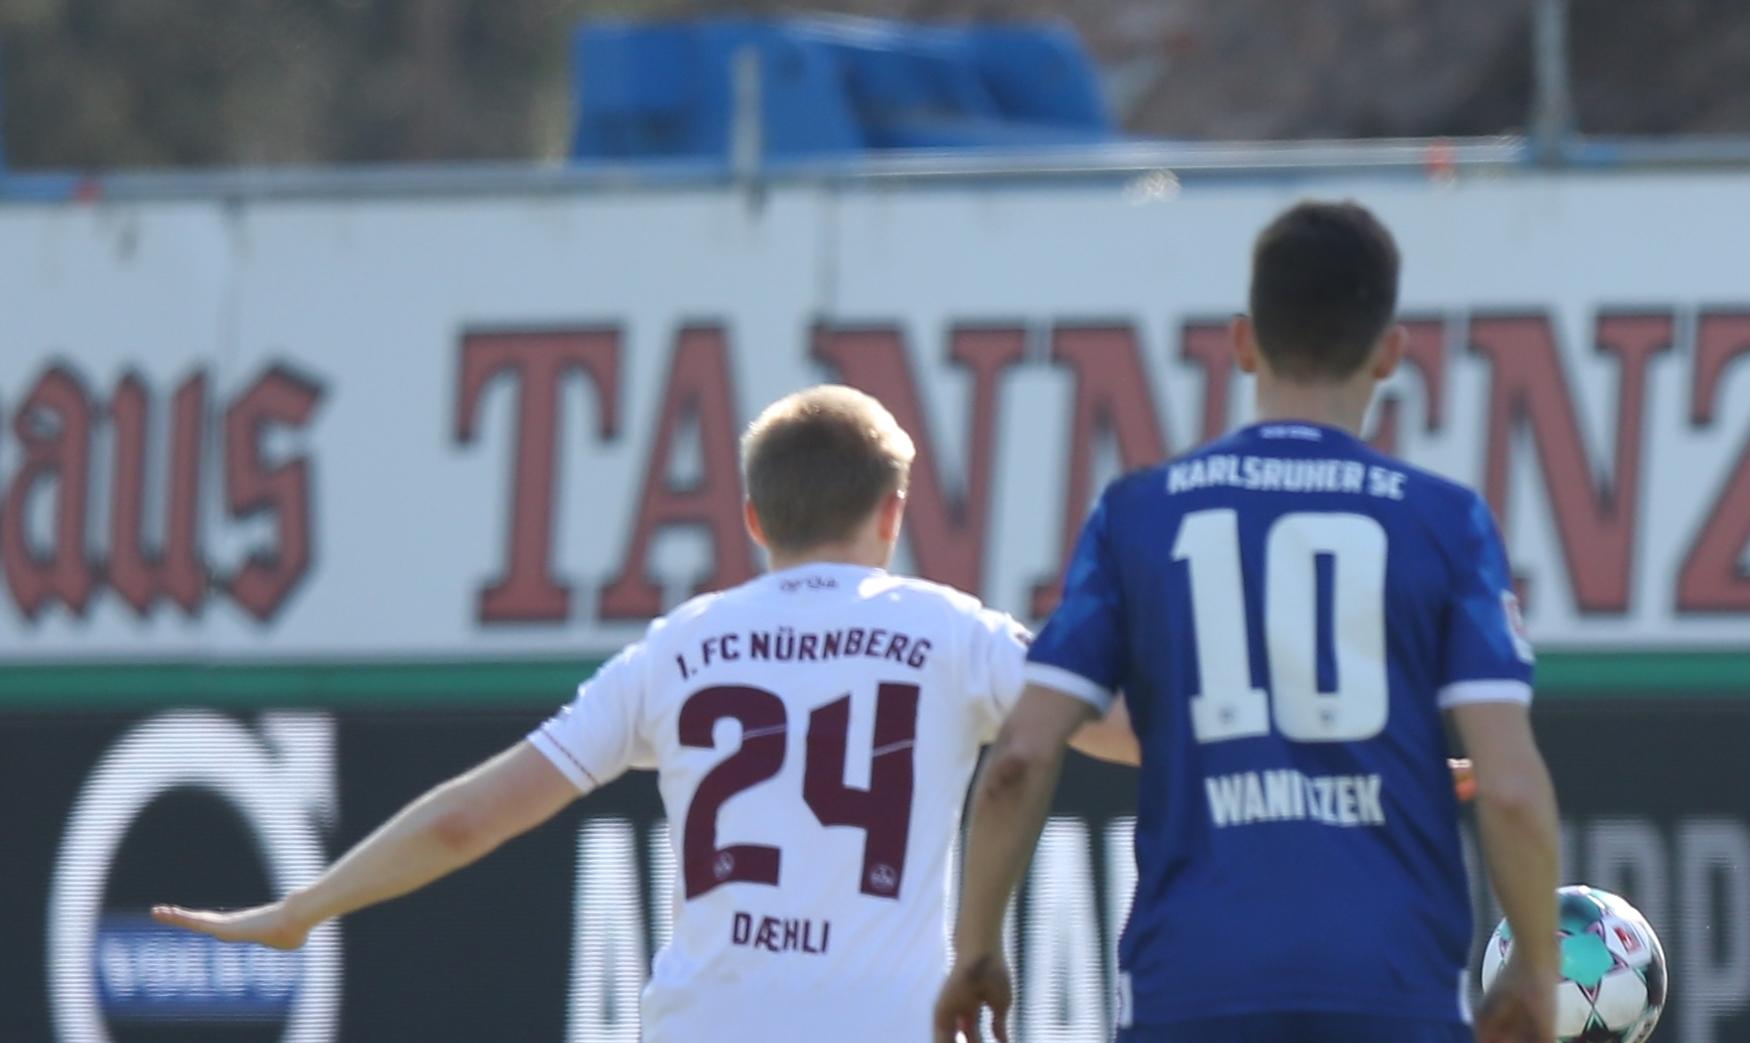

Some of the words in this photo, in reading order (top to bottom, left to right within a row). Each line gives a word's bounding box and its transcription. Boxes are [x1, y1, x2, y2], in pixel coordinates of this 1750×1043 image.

[1167, 453, 1365, 495] KARLSRUHER
[1366, 463, 1407, 501] SC
[702, 632, 739, 667] FC
[750, 625, 932, 671] NÜRNBERG
[1171, 507, 1389, 744] 10
[677, 681, 921, 902] 24
[730, 911, 832, 956] DÆHLI
